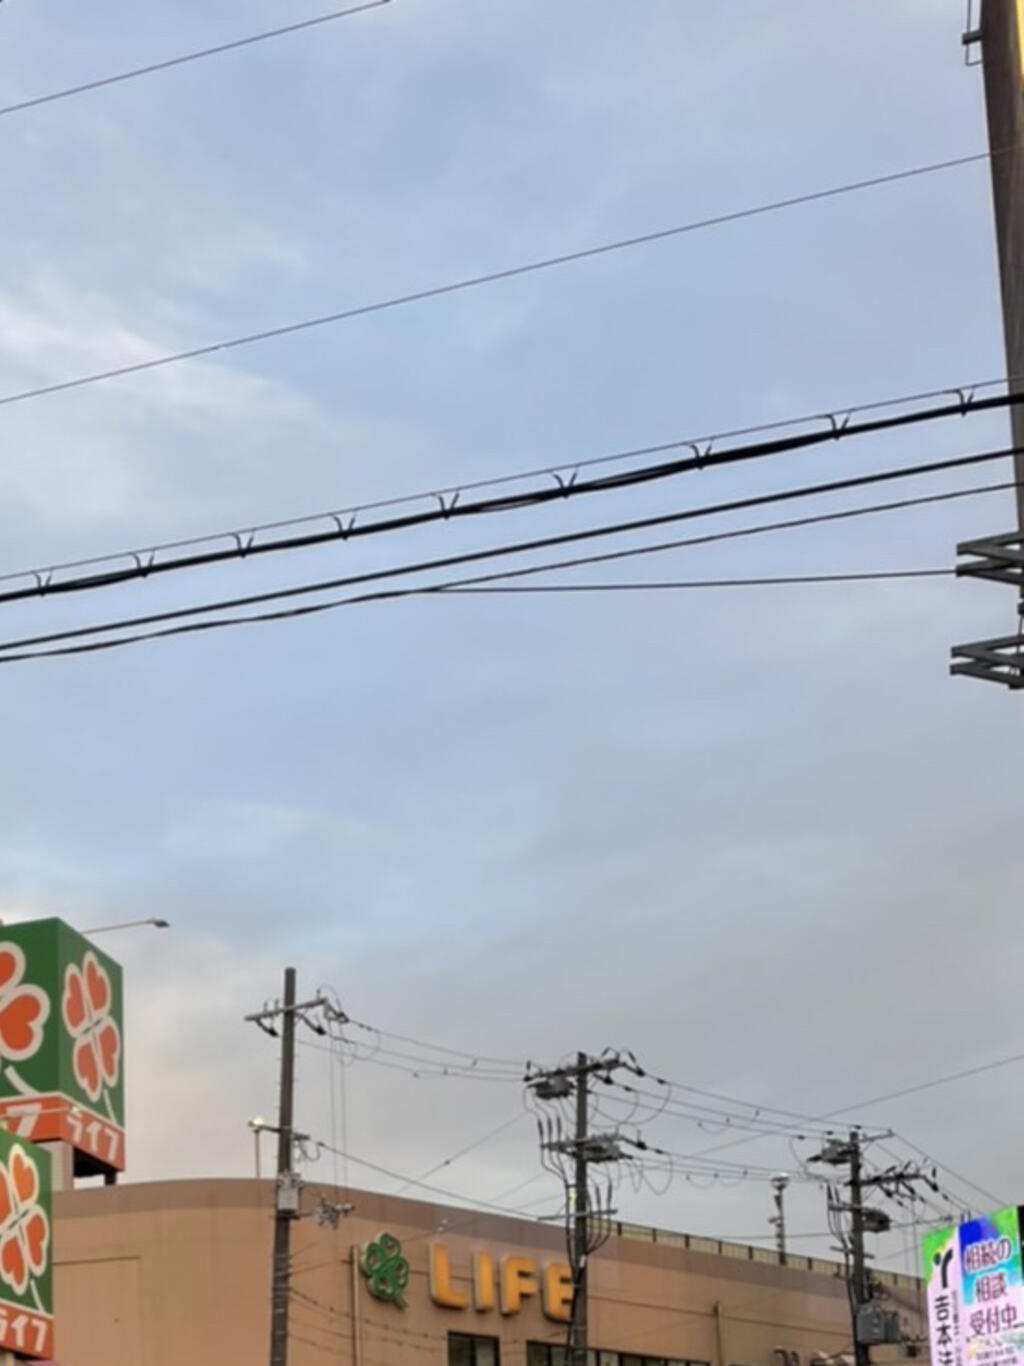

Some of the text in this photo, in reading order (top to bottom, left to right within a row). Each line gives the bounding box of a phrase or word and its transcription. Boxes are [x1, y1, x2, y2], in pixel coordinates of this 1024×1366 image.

[67, 1110, 119, 1161] ライフ
[966, 1238, 1011, 1271] 相続の
[430, 1241, 573, 1323] LIFE
[976, 1273, 1007, 1302] 相談
[970, 1303, 1017, 1336] 受付中
